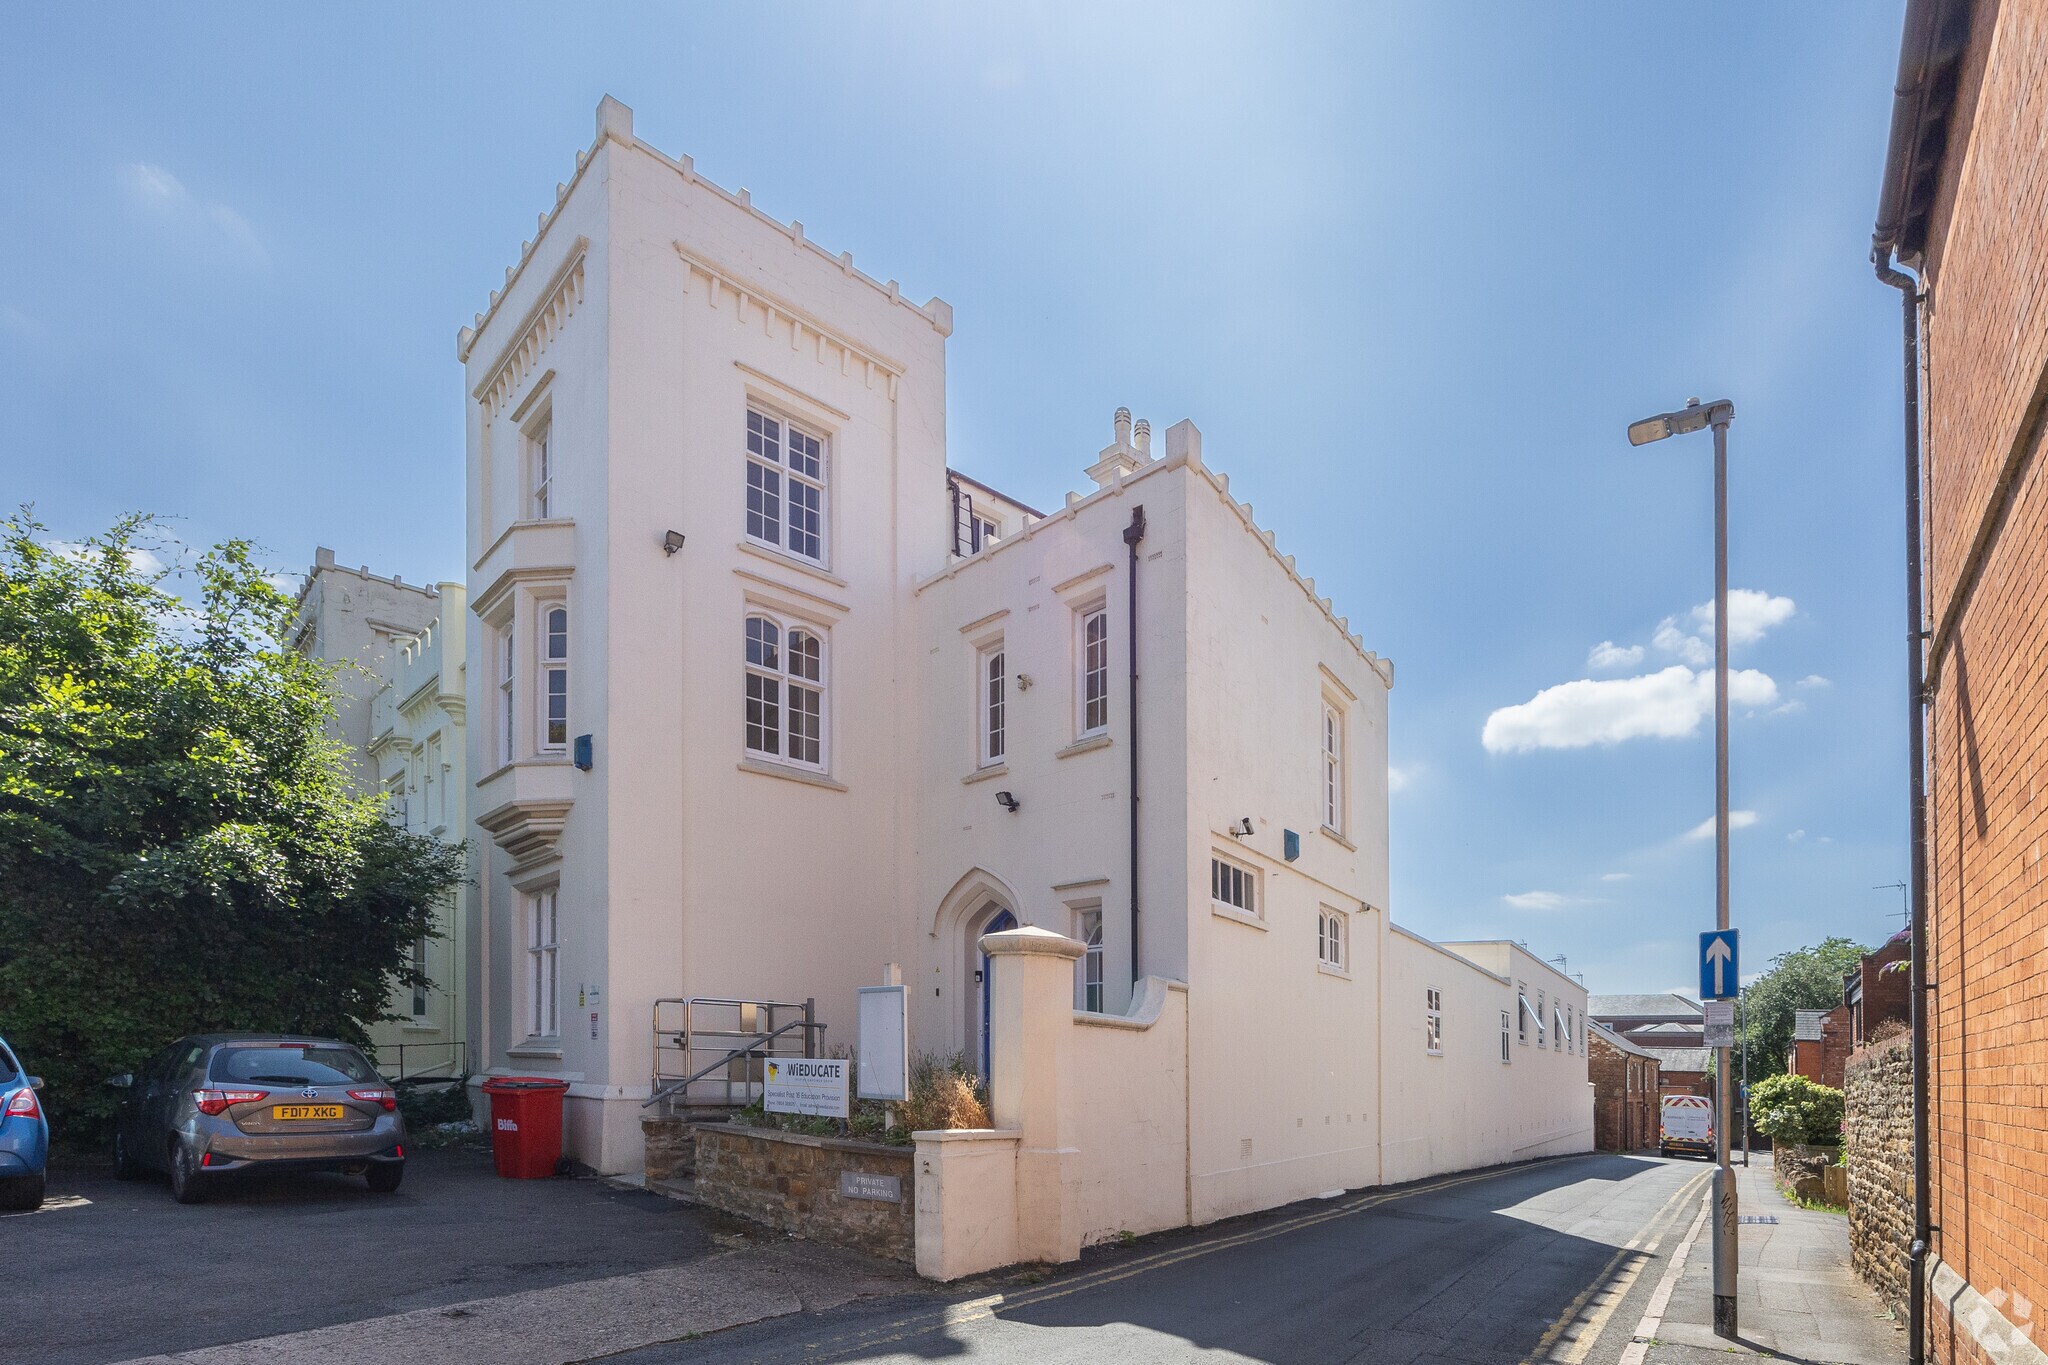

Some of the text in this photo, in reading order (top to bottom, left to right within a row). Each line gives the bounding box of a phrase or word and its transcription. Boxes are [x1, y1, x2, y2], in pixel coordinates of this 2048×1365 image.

[787, 1063, 840, 1078] WiEDUCATE
[801, 1092, 820, 1100] Education
[821, 1093, 841, 1101] Provision
[281, 1107, 337, 1118] FD17 XKG
[497, 1118, 518, 1131] Biffa
[856, 1176, 884, 1187] PRIVATE
[848, 1186, 894, 1198] NO PARKING
